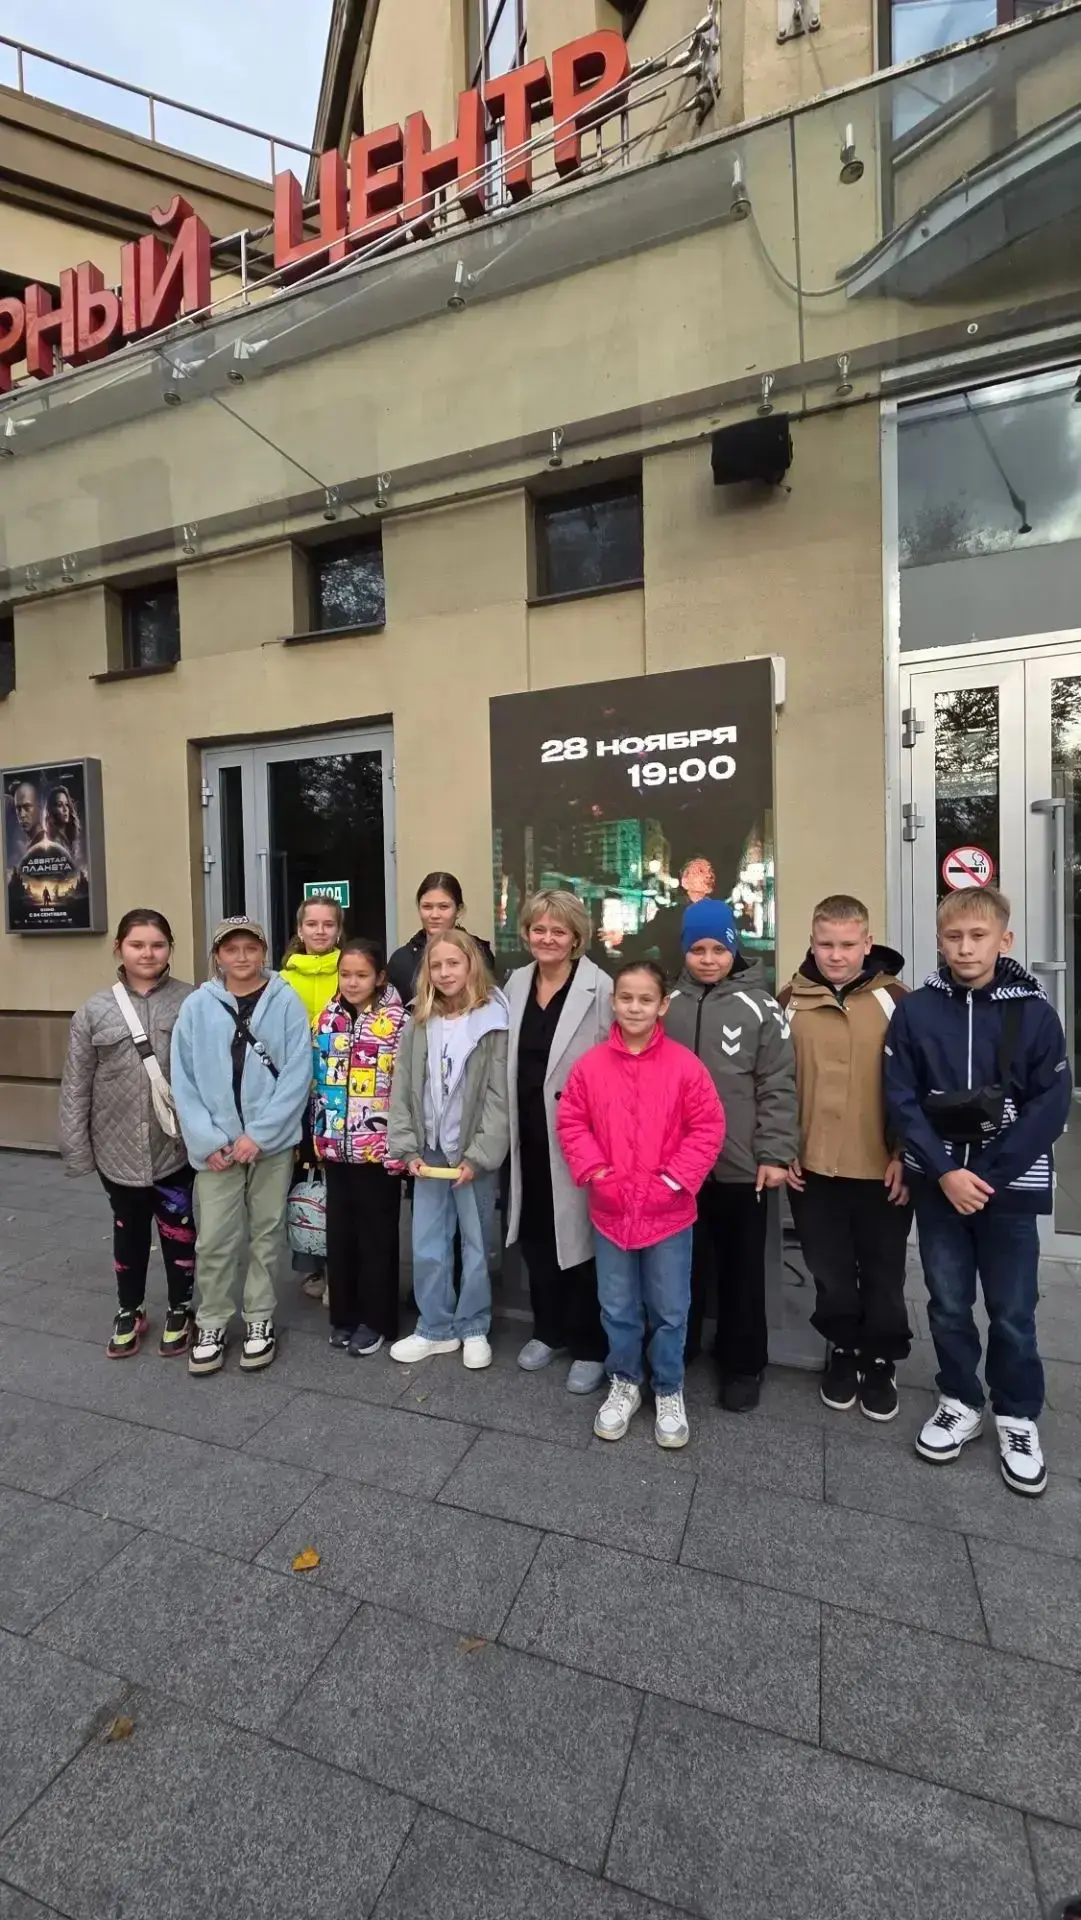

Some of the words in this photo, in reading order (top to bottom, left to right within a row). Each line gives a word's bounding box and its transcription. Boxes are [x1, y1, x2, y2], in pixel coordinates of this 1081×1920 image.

[273, 29, 632, 284] ЦЕНТР
[541, 736, 588, 763] 28
[596, 725, 737, 757] НОЯБРЯ
[627, 755, 737, 788] 19:00
[22, 863, 72, 872] ПЛАНЕТА
